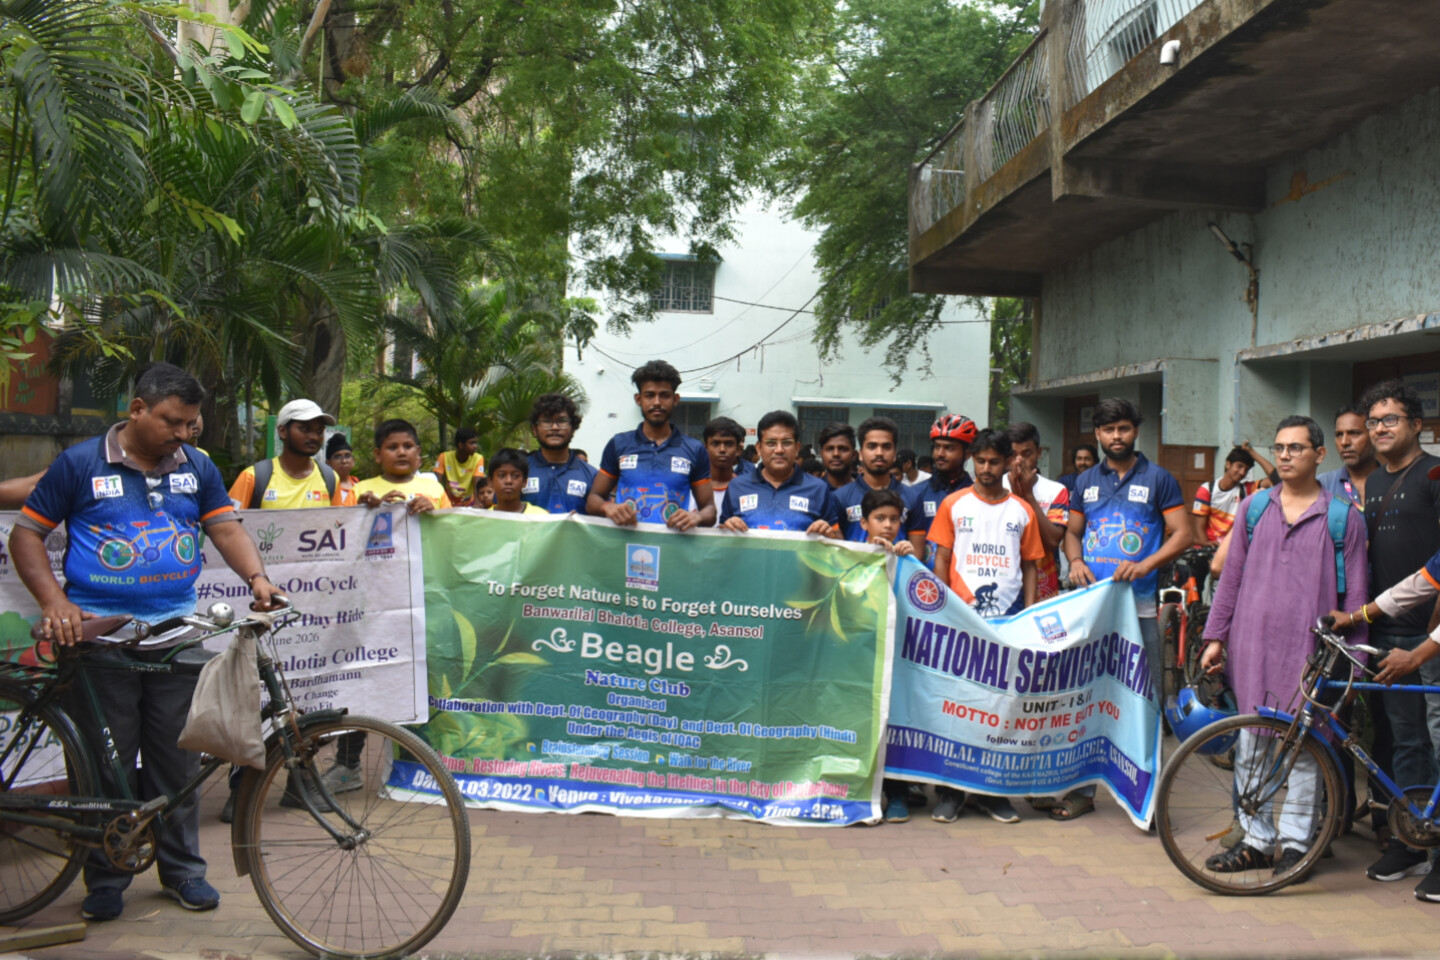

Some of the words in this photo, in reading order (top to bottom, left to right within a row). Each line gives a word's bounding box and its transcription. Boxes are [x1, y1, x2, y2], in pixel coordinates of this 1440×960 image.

[94, 476, 119, 491] FIT
[96, 488, 121, 498] INDIA
[957, 515, 975, 528] FIT
[258, 540, 274, 554] Up
[297, 528, 346, 552] SAI
[972, 542, 1006, 556] WORLD
[966, 553, 1010, 568] BICYCLE
[89, 573, 135, 586] WORLD
[139, 570, 189, 585] BICYCLE
[977, 566, 998, 578] DAY
[486, 580, 505, 597] To
[510, 581, 566, 600] Forget
[569, 584, 622, 606] Nature
[625, 592, 639, 608] is
[641, 594, 657, 611] to
[660, 597, 717, 618] Forget
[720, 600, 803, 621] Ourselves
[301, 613, 333, 630] Day
[336, 608, 365, 626] Ride
[522, 604, 595, 622] Banwarilal
[597, 607, 649, 630] Bhalotia
[651, 617, 707, 639] College,
[708, 622, 764, 639] Asansol
[293, 632, 320, 645] 2026
[331, 645, 399, 667] College
[580, 631, 695, 675] Beagle
[901, 615, 1010, 691] NATIONAL
[1014, 638, 1099, 695] SERVICE
[290, 670, 362, 690] Bardhamann
[585, 669, 647, 692] Nature
[648, 677, 691, 698] Club
[303, 687, 339, 702] Change
[607, 692, 667, 712] Organised
[941, 699, 1000, 728] MOTTO
[1014, 716, 1047, 732] NOT
[1050, 712, 1071, 730] ME
[1075, 703, 1095, 725] BUT
[1097, 699, 1120, 721] YOU
[1022, 700, 1059, 714] UNIT
[428, 695, 505, 714] Collaboration
[507, 700, 534, 716] with
[535, 702, 567, 718] Dept.
[568, 705, 582, 719] Of
[583, 705, 646, 726] Geography
[681, 717, 704, 732] and
[705, 721, 738, 736] Dept.
[739, 722, 753, 736] Of
[753, 724, 817, 740] Geography
[566, 721, 604, 737] Under
[605, 723, 625, 738] the
[626, 727, 659, 744] Aegis
[660, 732, 673, 746] of
[673, 733, 701, 749] IQAC
[986, 733, 1019, 747] follow
[1020, 738, 1037, 748] us:
[611, 744, 650, 763] Session
[886, 727, 976, 764] BANWARILAL
[980, 750, 1052, 771] BHALOTIA
[668, 752, 693, 768] Walk
[694, 755, 709, 770] for
[710, 756, 726, 771] the
[726, 758, 752, 773] River
[472, 757, 527, 777] Restoring
[570, 762, 645, 786] Rejuvenating
[646, 770, 666, 788] the
[667, 771, 714, 793] lifelines
[715, 776, 728, 793] in
[729, 777, 748, 795] the
[749, 779, 771, 797] City
[771, 781, 785, 798] of
[548, 785, 598, 804] Venue
